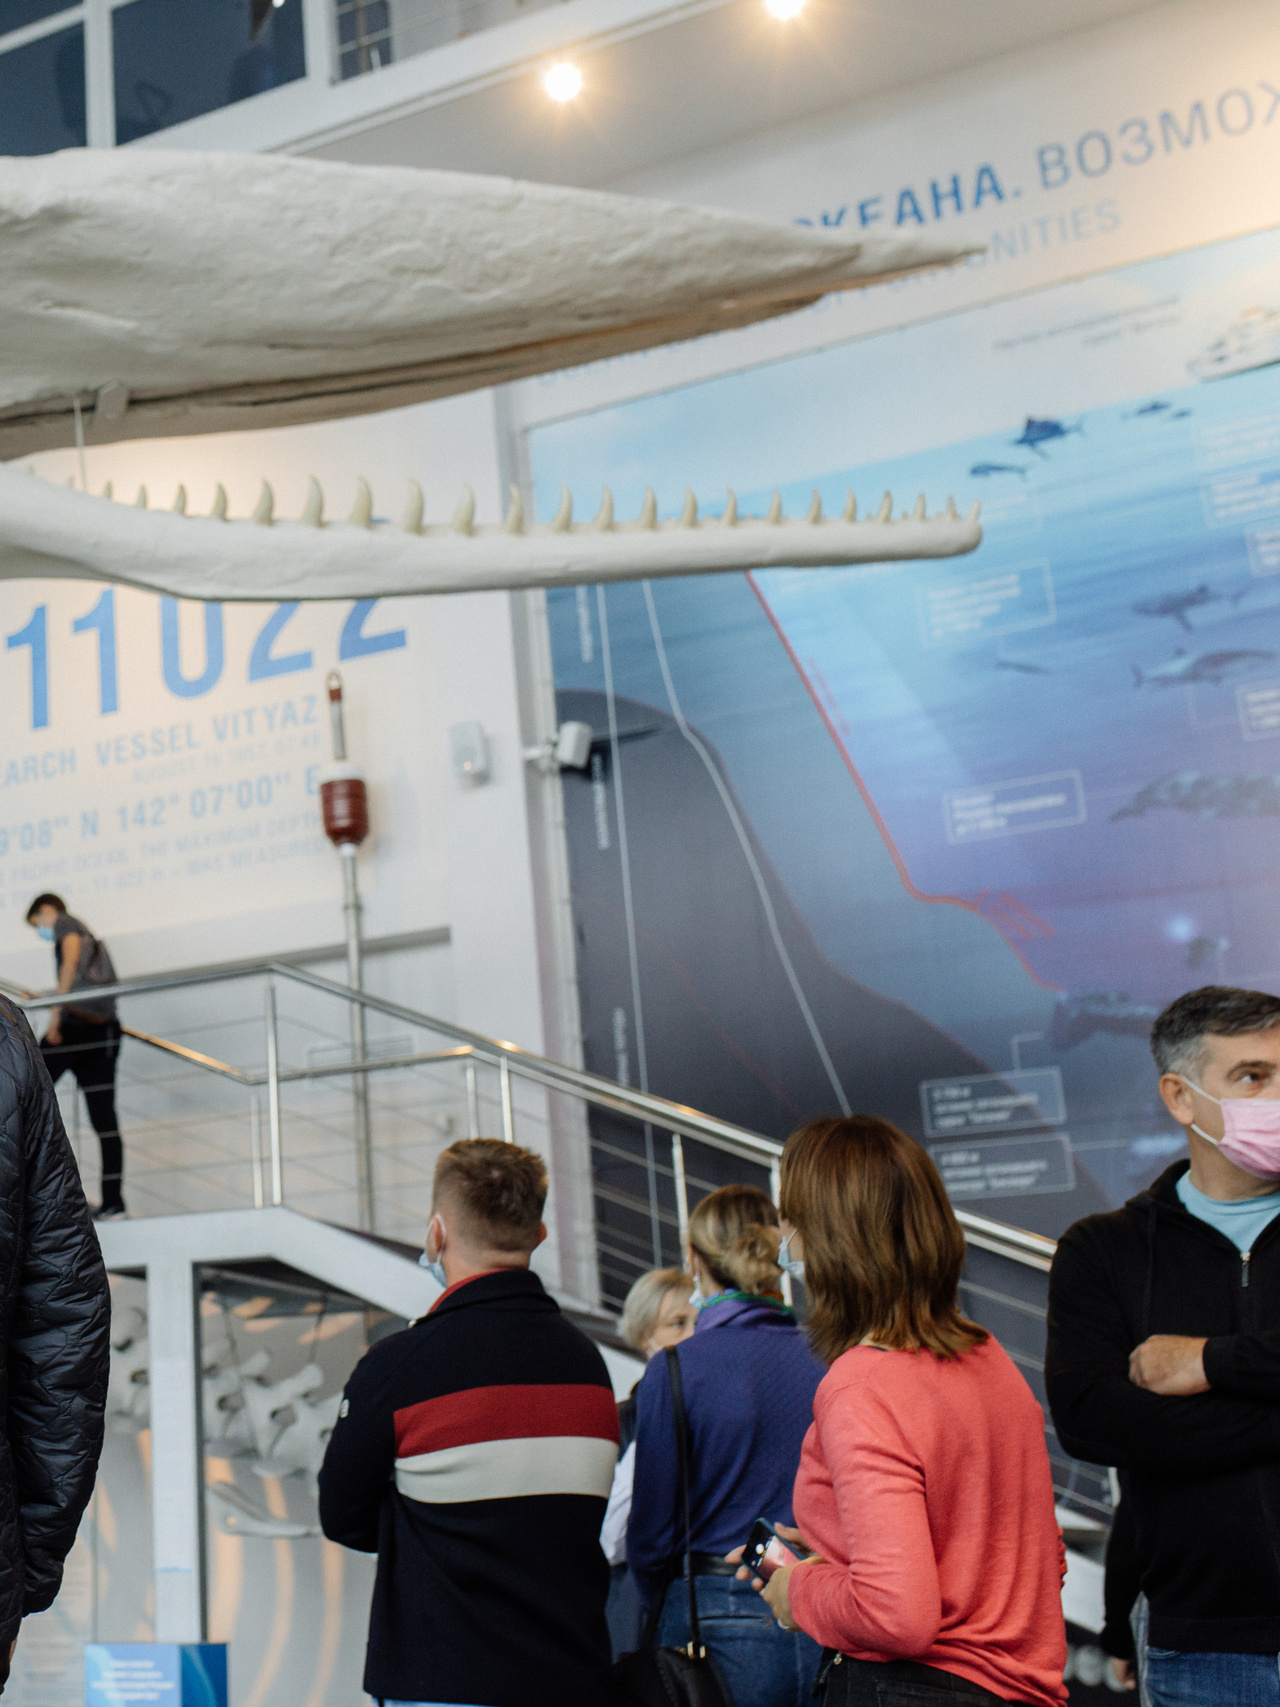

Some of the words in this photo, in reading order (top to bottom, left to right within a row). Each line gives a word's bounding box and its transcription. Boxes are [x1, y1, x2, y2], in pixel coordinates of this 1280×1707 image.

[794, 162, 1021, 227] ЕАНА.
[7, 587, 407, 731] 11022
[95, 723, 200, 768] VESSEL
[213, 694, 318, 743] VITYAZ
[81, 809, 99, 839] N
